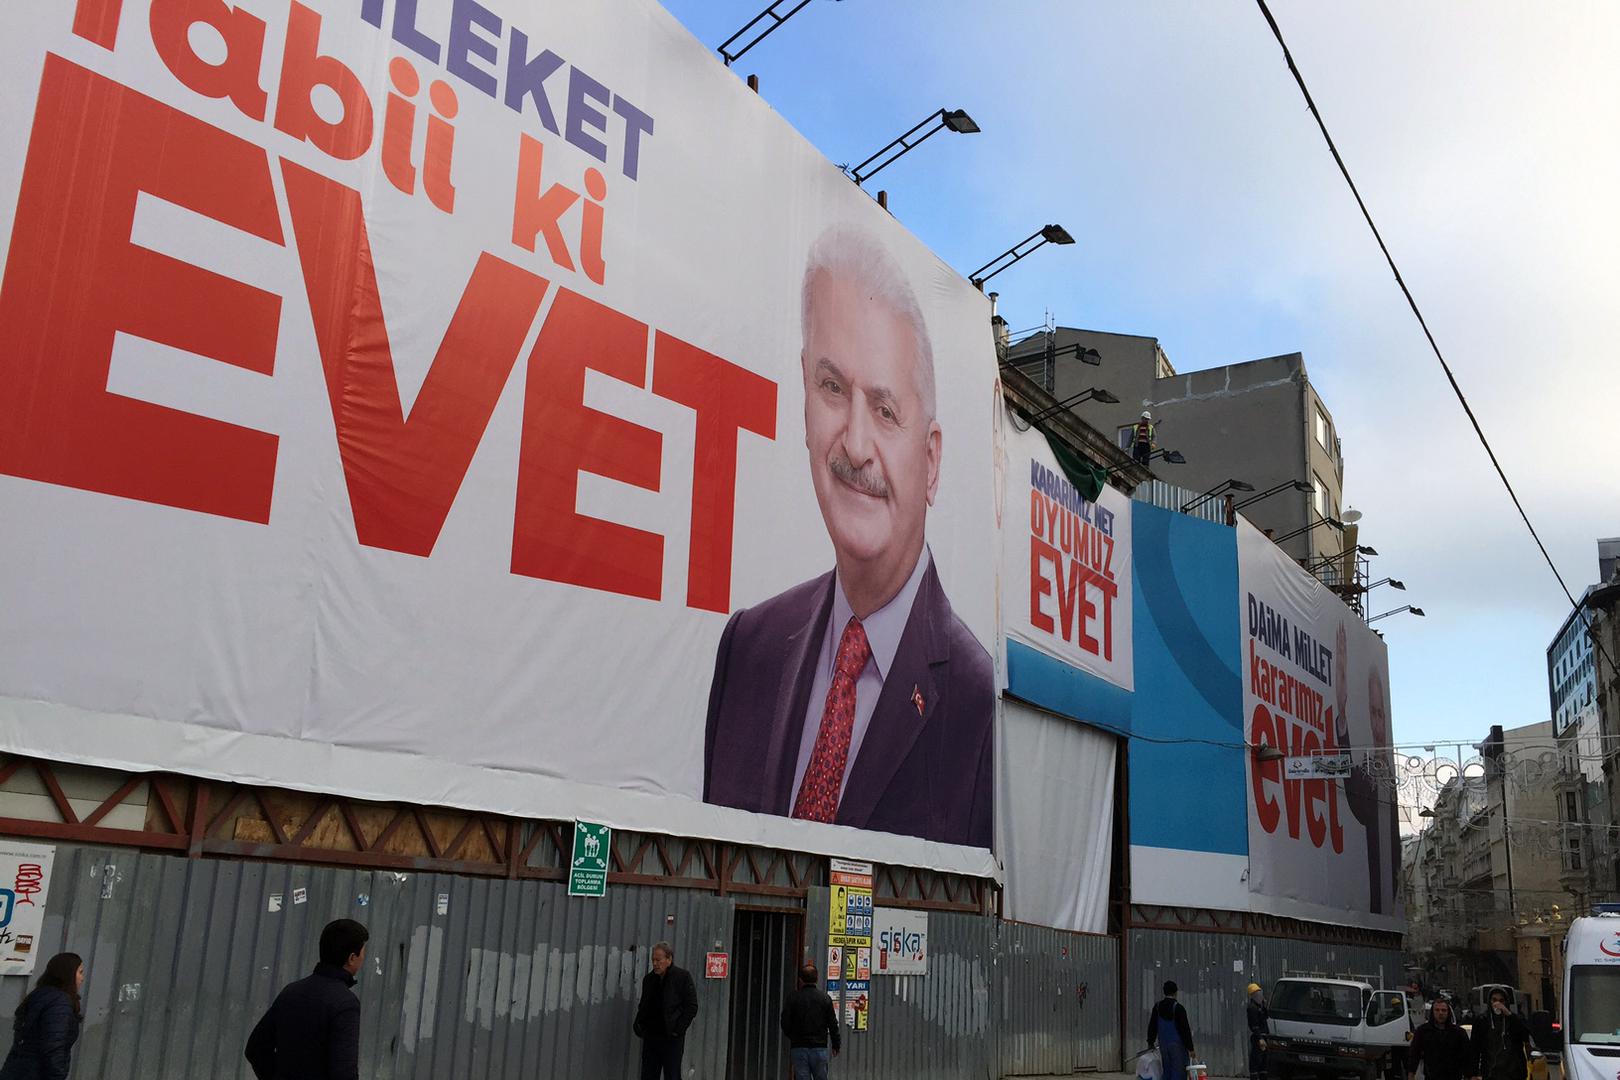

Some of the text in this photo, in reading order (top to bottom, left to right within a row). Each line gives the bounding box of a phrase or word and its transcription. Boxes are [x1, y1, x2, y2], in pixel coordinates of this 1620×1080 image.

[72, 0, 607, 286] abii ki
[360, 0, 655, 183] LEKET
[0, 51, 779, 615] EVET
[1031, 458, 1115, 538] KARARIMIZ NET
[1031, 488, 1115, 581] OYUMUZ
[1031, 534, 1118, 662] EVET
[1251, 703, 1344, 855] evet
[880, 926, 921, 957] siska
